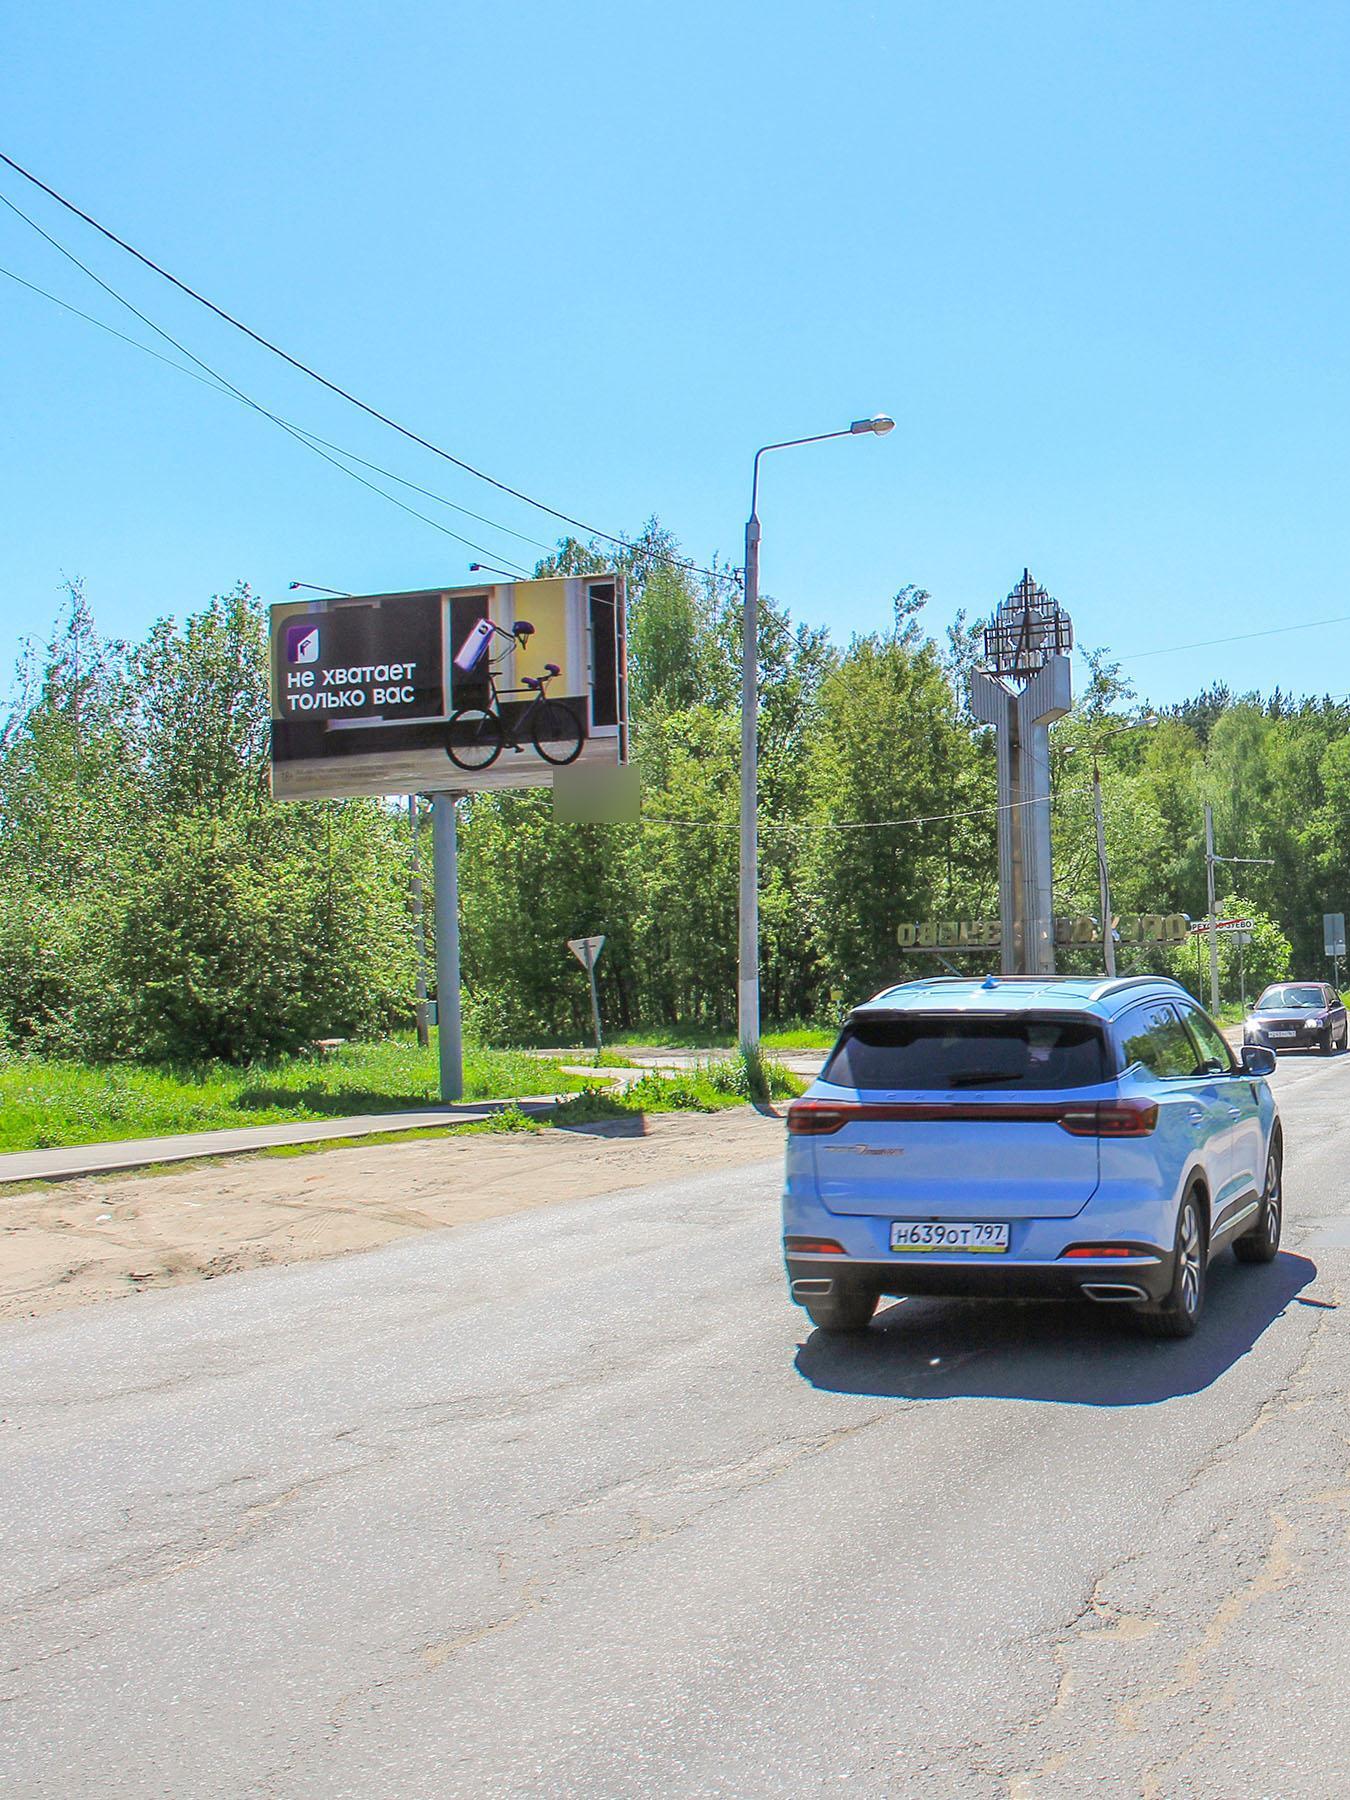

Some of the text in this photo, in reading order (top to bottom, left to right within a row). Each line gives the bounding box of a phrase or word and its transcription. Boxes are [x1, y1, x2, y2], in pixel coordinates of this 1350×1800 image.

[287, 663, 416, 688] не хватает
[287, 685, 415, 711] только вас
